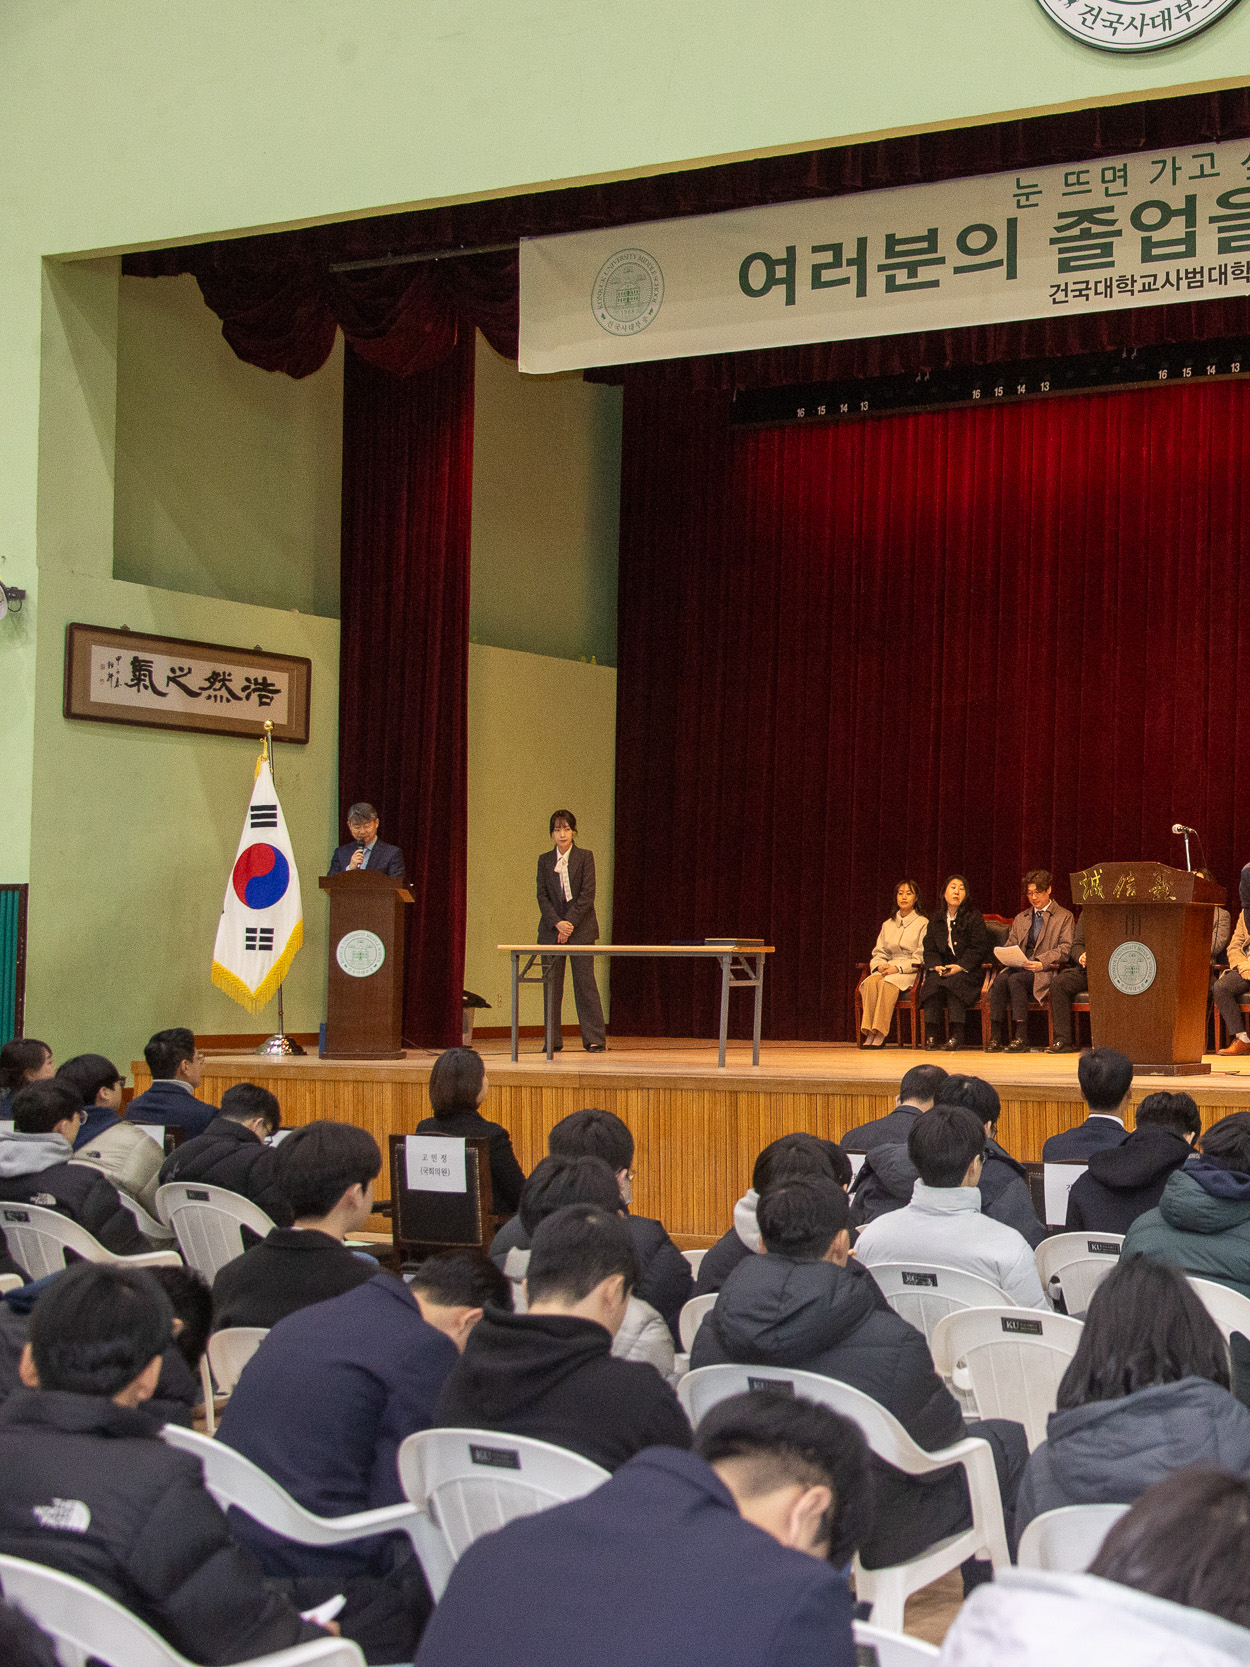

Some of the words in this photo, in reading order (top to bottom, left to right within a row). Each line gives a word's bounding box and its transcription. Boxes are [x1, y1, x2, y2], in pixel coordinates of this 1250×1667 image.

[1078, 0, 1214, 38] 건국사대부
[1012, 177, 1043, 209] 눈
[1062, 163, 1129, 198] 뜨면
[1148, 152, 1221, 186] 가고
[738, 216, 1019, 306] 여러분의
[1158, 369, 1168, 380] 16
[1182, 367, 1192, 378] 15
[1206, 365, 1216, 375] 14
[1230, 362, 1240, 373] 13
[972, 389, 981, 399] 16
[994, 386, 1004, 397] 15
[1017, 384, 1026, 394] 14
[1040, 381, 1050, 392] 13
[420, 1166, 451, 1177] (국회의원)
[1091, 1243, 1102, 1251] KU
[1006, 1320, 1020, 1329] KU
